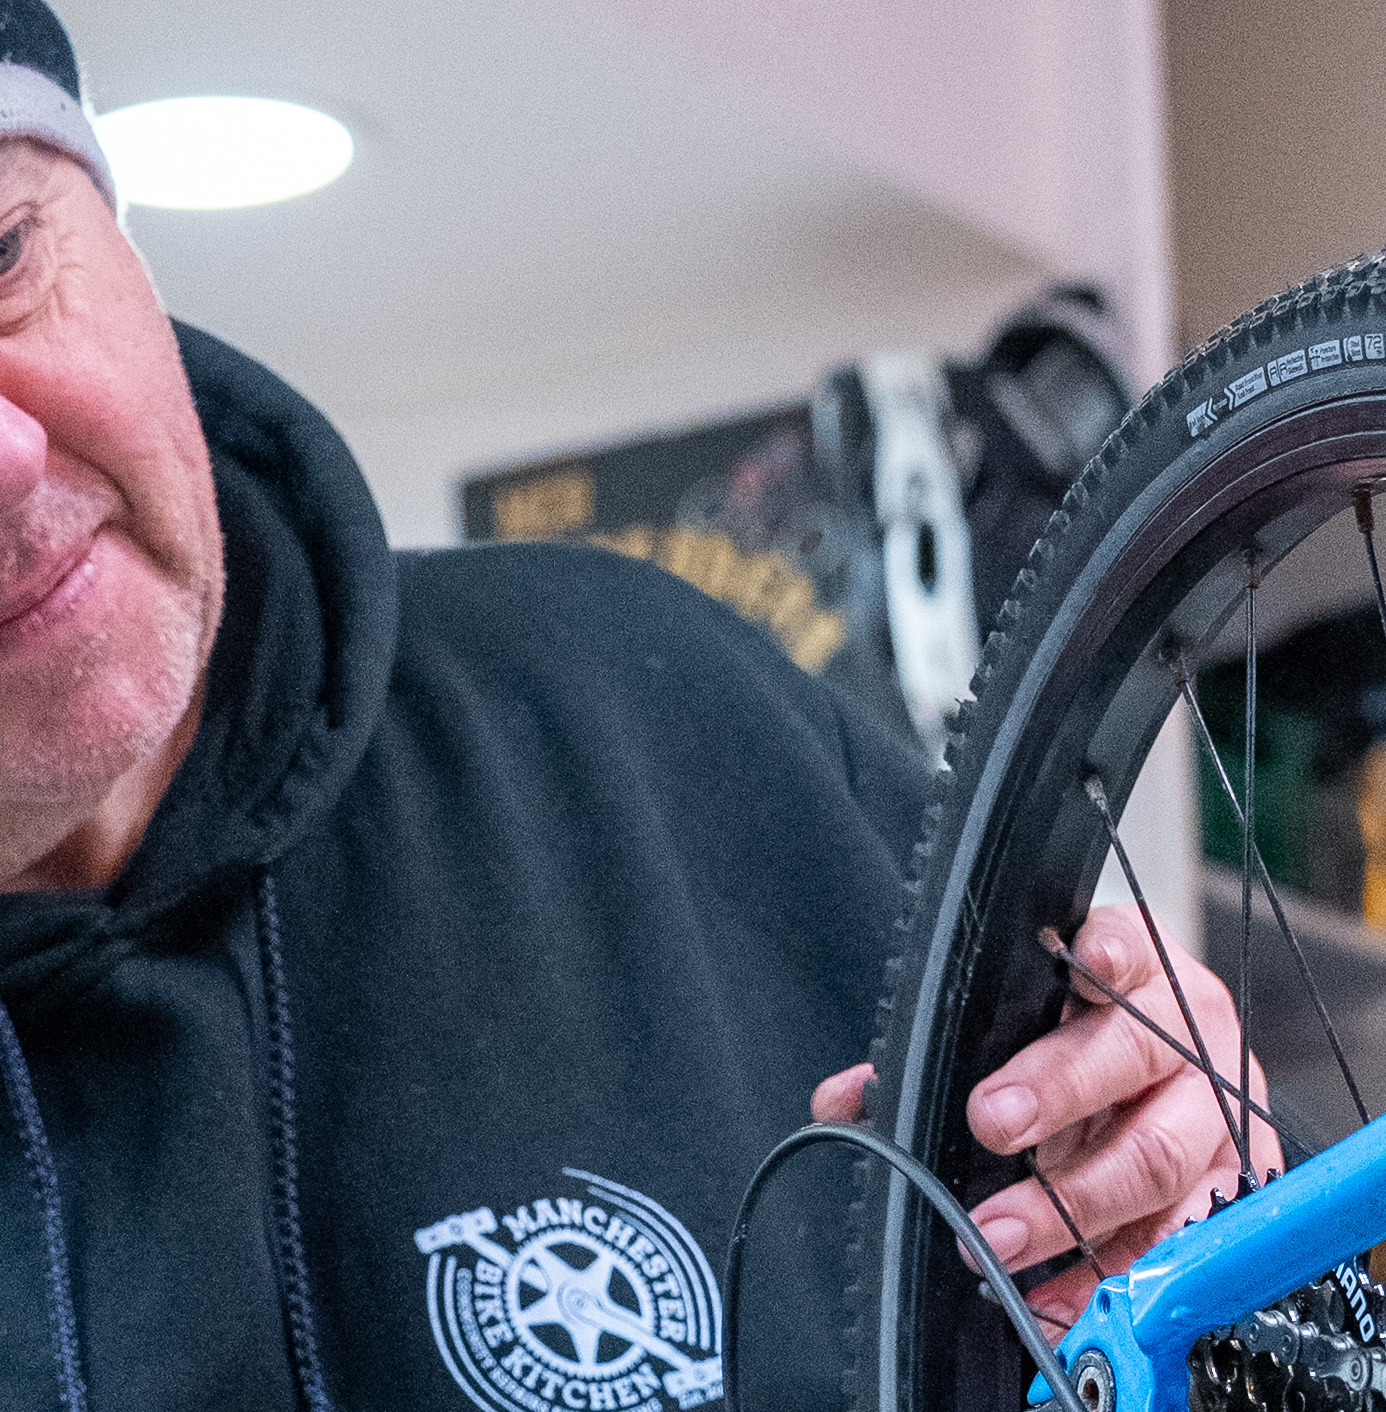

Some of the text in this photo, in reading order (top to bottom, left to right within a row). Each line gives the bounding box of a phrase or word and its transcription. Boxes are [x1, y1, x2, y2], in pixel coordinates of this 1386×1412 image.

[1365, 335, 1382, 350] 72
[473, 1259, 663, 1411] BIKE KITCHEN
[502, 1197, 688, 1342] MANCHESTER
